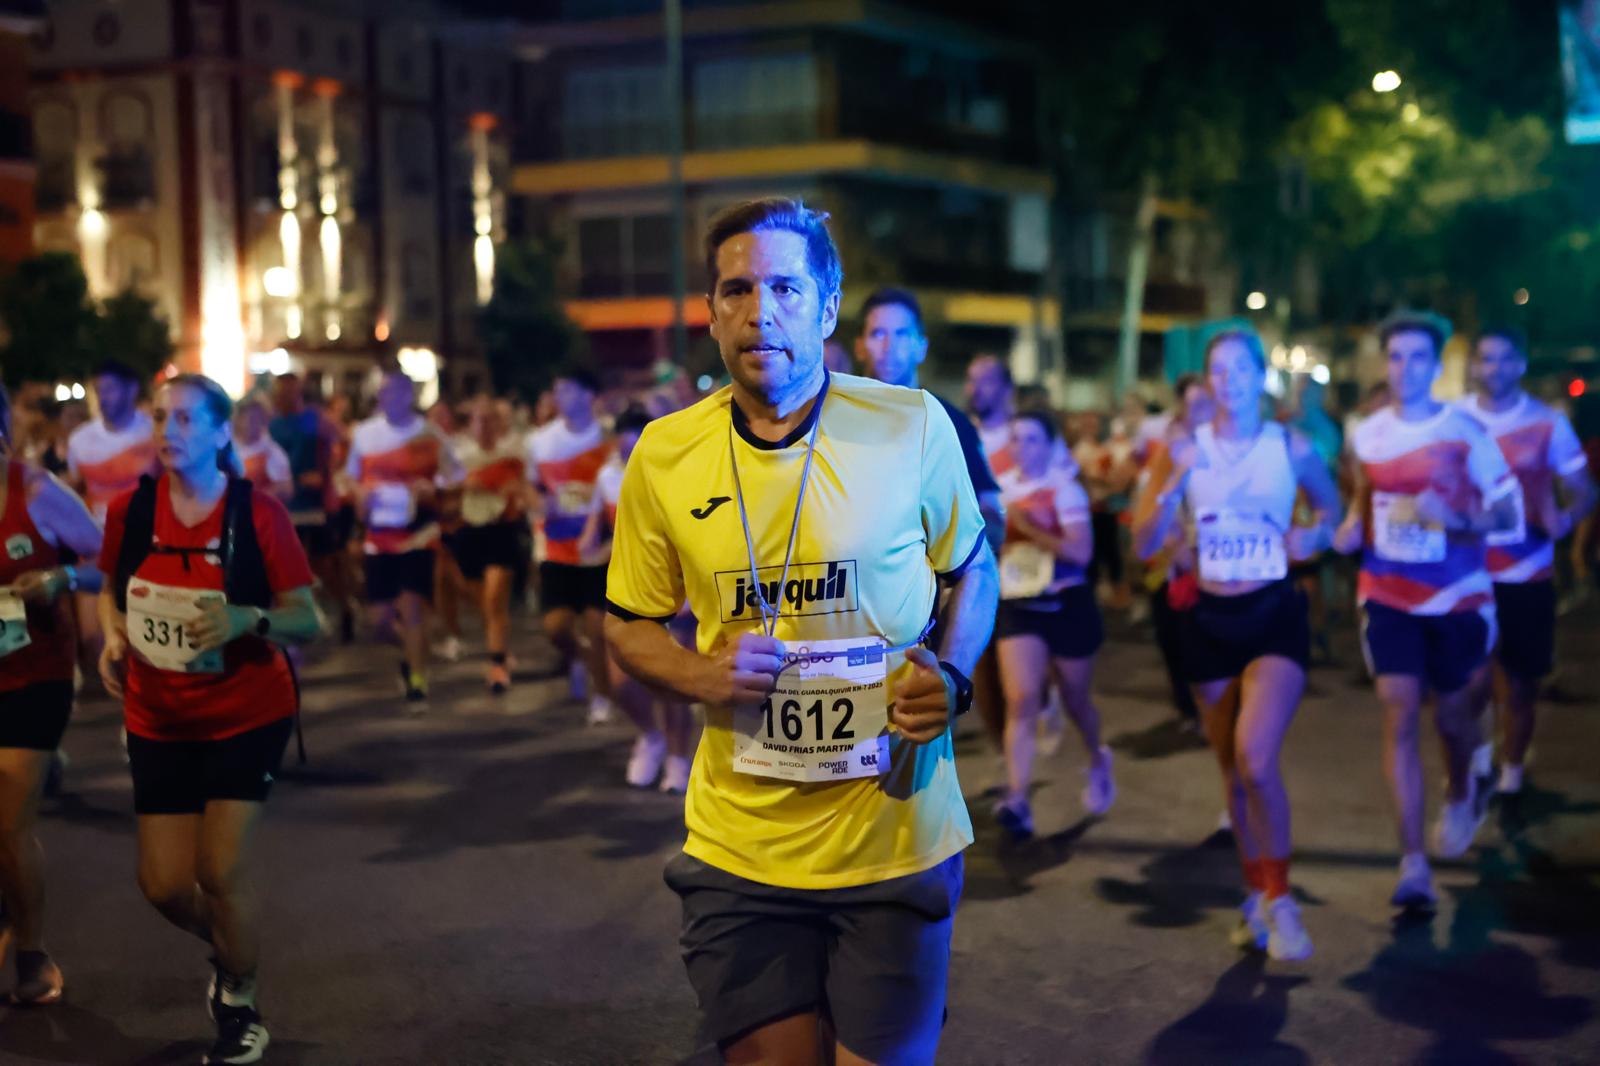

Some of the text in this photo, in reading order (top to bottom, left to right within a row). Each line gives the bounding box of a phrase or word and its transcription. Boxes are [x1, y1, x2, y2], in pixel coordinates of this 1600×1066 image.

[731, 562, 847, 616] jarquil
[801, 685, 852, 696] GUADALQUIVIR
[868, 682, 883, 690] 2025
[760, 697, 856, 742] 1612
[762, 742, 855, 754] DAVID FRIAS MARTIN
[818, 760, 848, 769] POWER
